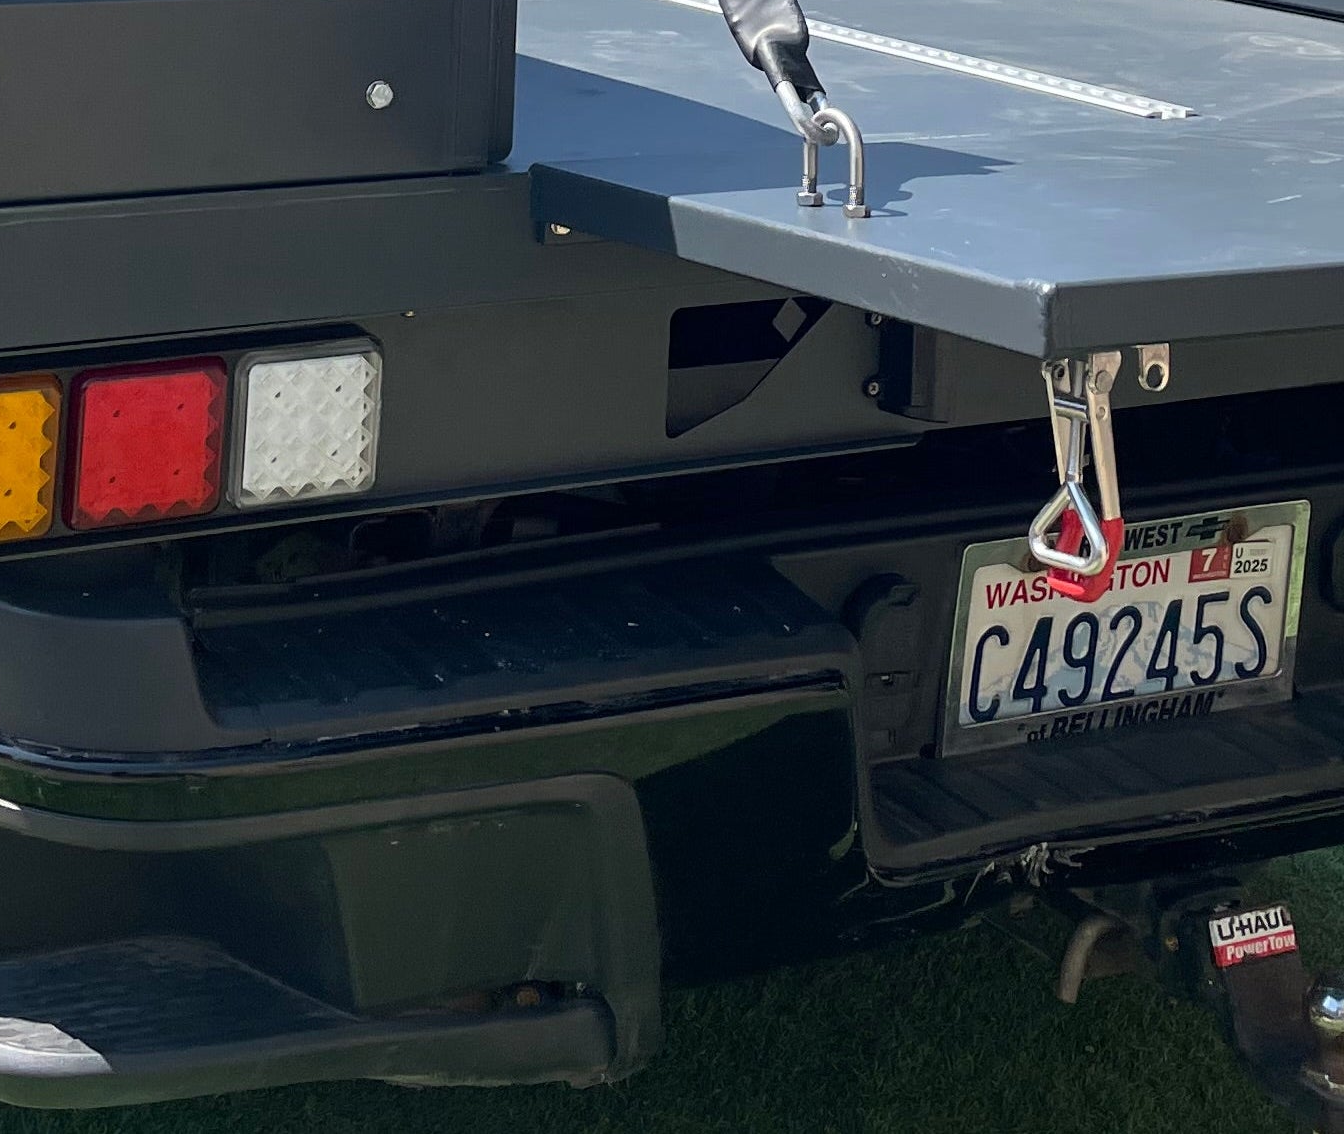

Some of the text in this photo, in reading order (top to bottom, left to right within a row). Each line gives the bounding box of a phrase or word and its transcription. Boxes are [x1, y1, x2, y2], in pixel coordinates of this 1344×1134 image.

[1201, 547, 1218, 572] 7
[1234, 558, 1268, 573] 2025
[1235, 548, 1244, 559] U
[968, 585, 1272, 722] C49245S
[1218, 908, 1291, 941] U-HAUL
[1226, 933, 1295, 961] PowerTow
